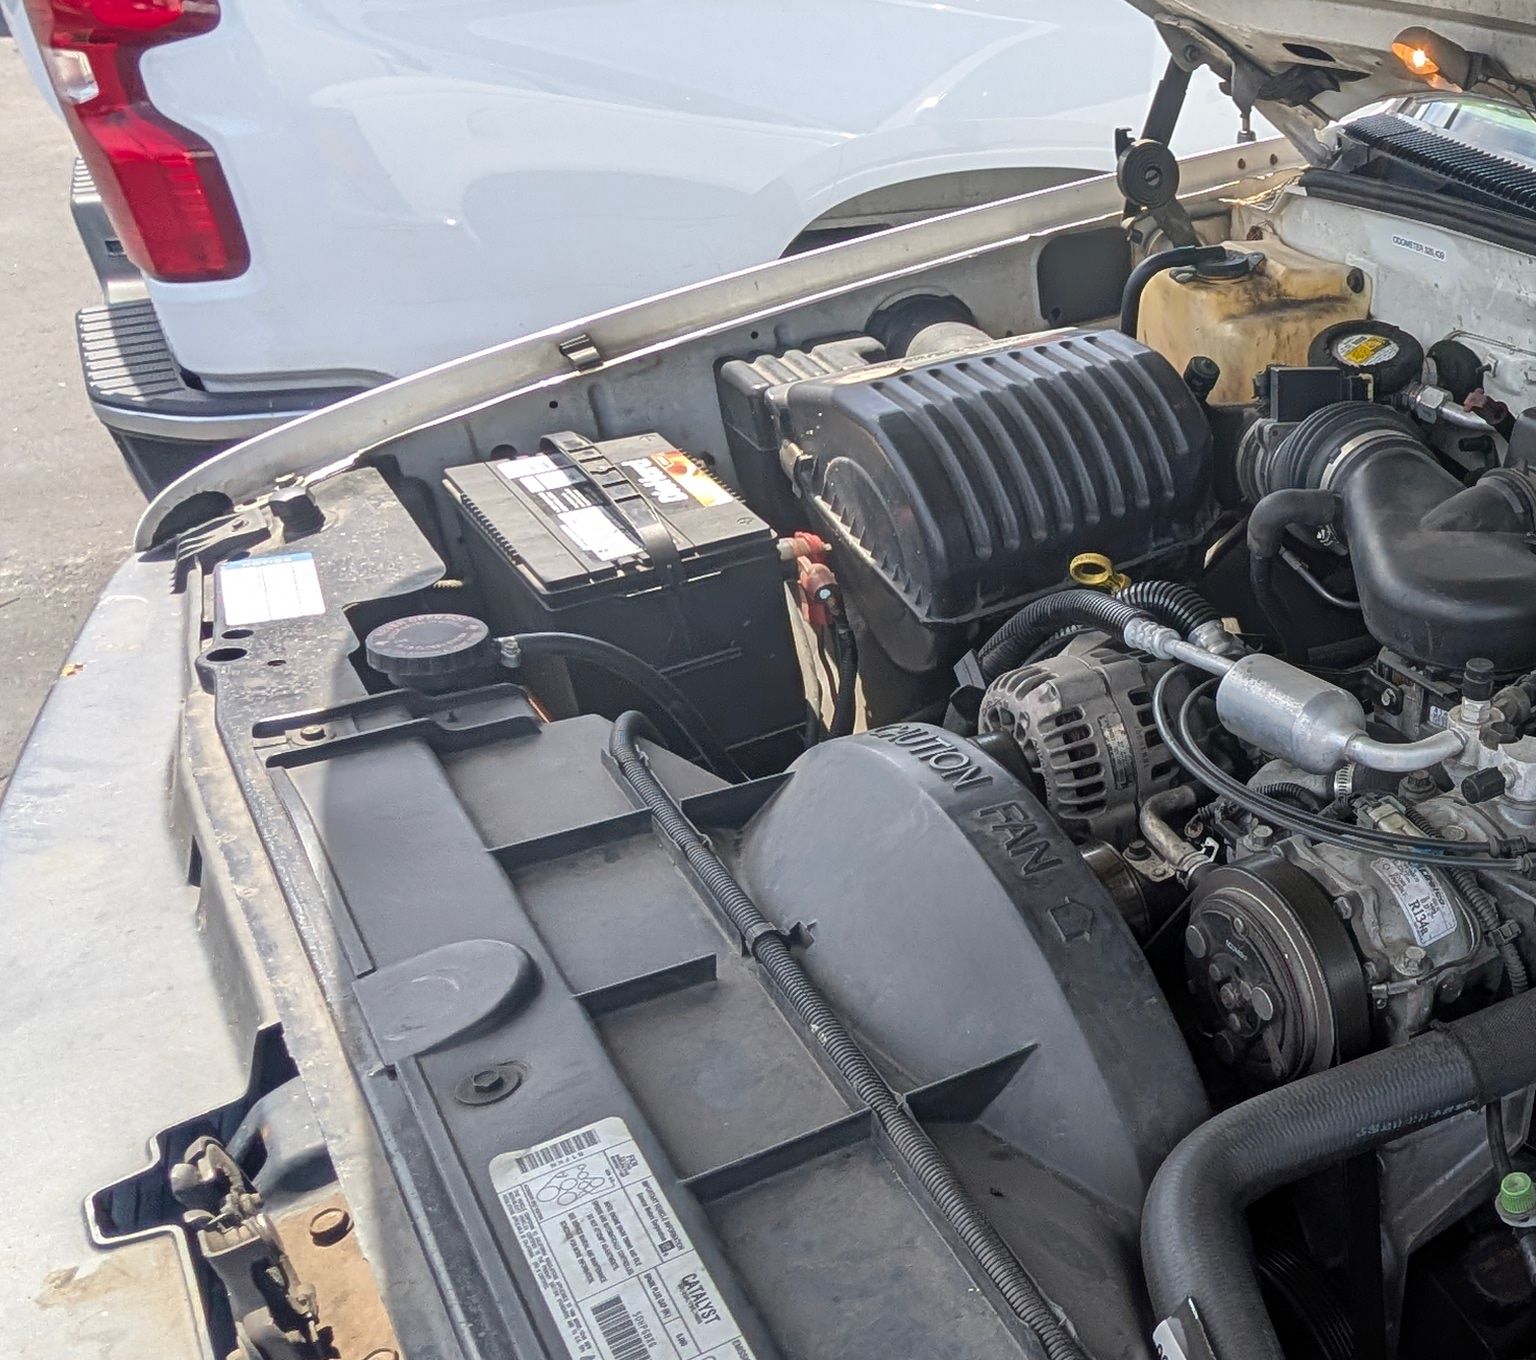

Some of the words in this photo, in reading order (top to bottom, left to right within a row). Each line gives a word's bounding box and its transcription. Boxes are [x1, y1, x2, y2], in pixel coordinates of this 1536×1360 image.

[872, 722, 994, 792] CAUTION
[973, 801, 1065, 876] FAN
[1408, 901, 1430, 935] R134a
[680, 1270, 721, 1327] CATALYST
